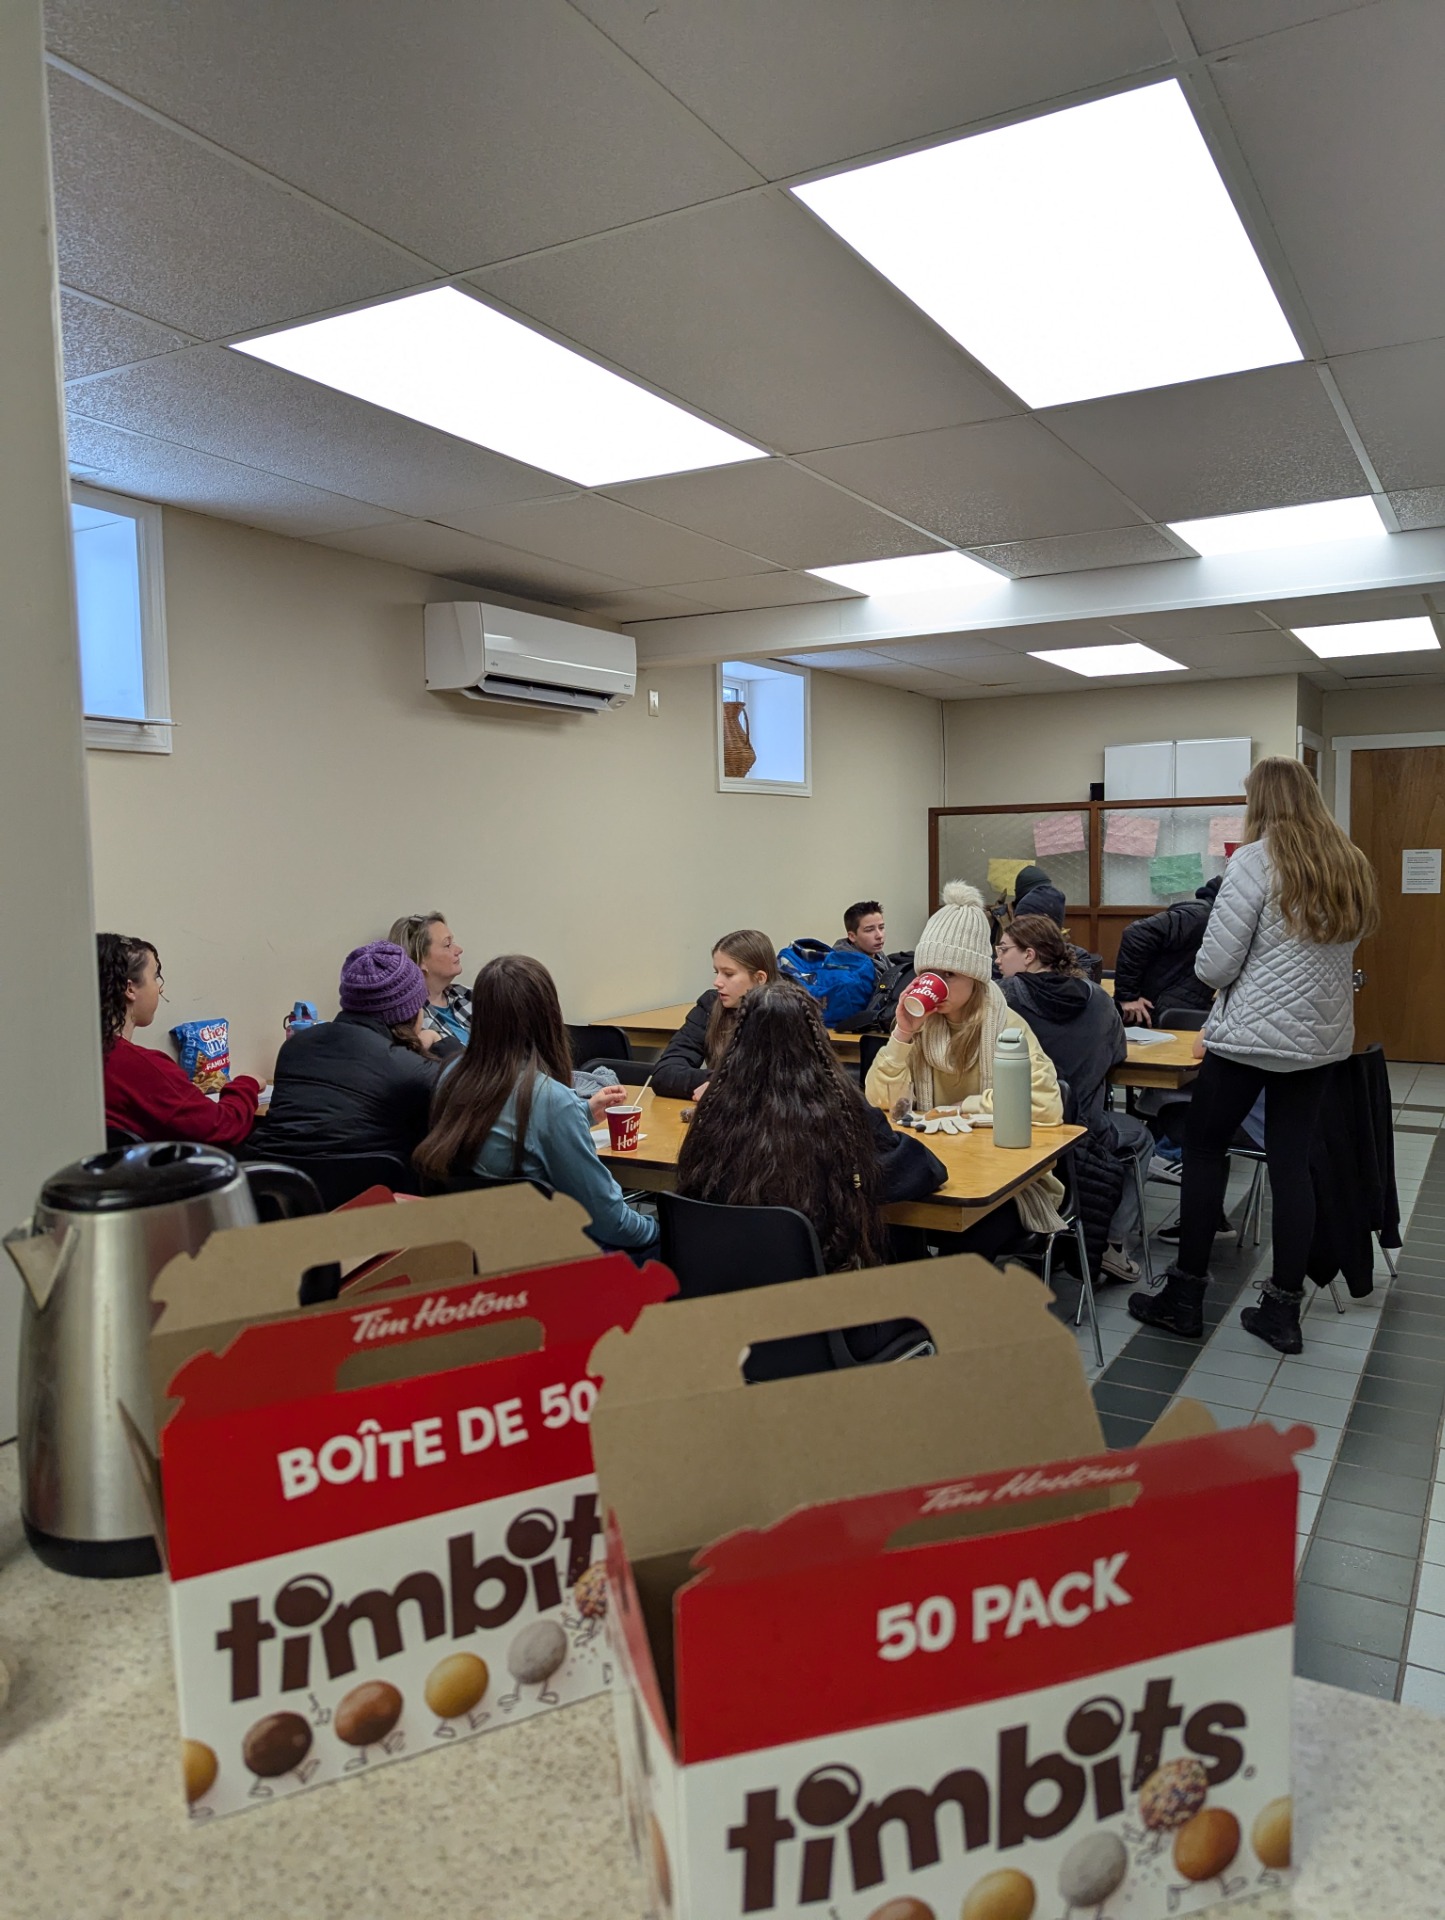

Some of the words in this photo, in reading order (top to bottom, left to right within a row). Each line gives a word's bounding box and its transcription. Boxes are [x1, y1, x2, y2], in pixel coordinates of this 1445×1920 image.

[909, 985, 939, 1003] ortons
[200, 1022, 227, 1042] Chex
[206, 1057, 226, 1070] FAMILY
[350, 1307, 409, 1343] Tim
[412, 1290, 529, 1331] Hortons
[277, 1418, 446, 1500] BOÎTE
[457, 1397, 529, 1455] DE
[540, 1379, 598, 1429] 50
[919, 1481, 991, 1515] Tim
[992, 1461, 1140, 1501] Hortons
[215, 1492, 602, 1702] timbit
[876, 1595, 957, 1662] 50
[971, 1551, 1133, 1643] PACK
